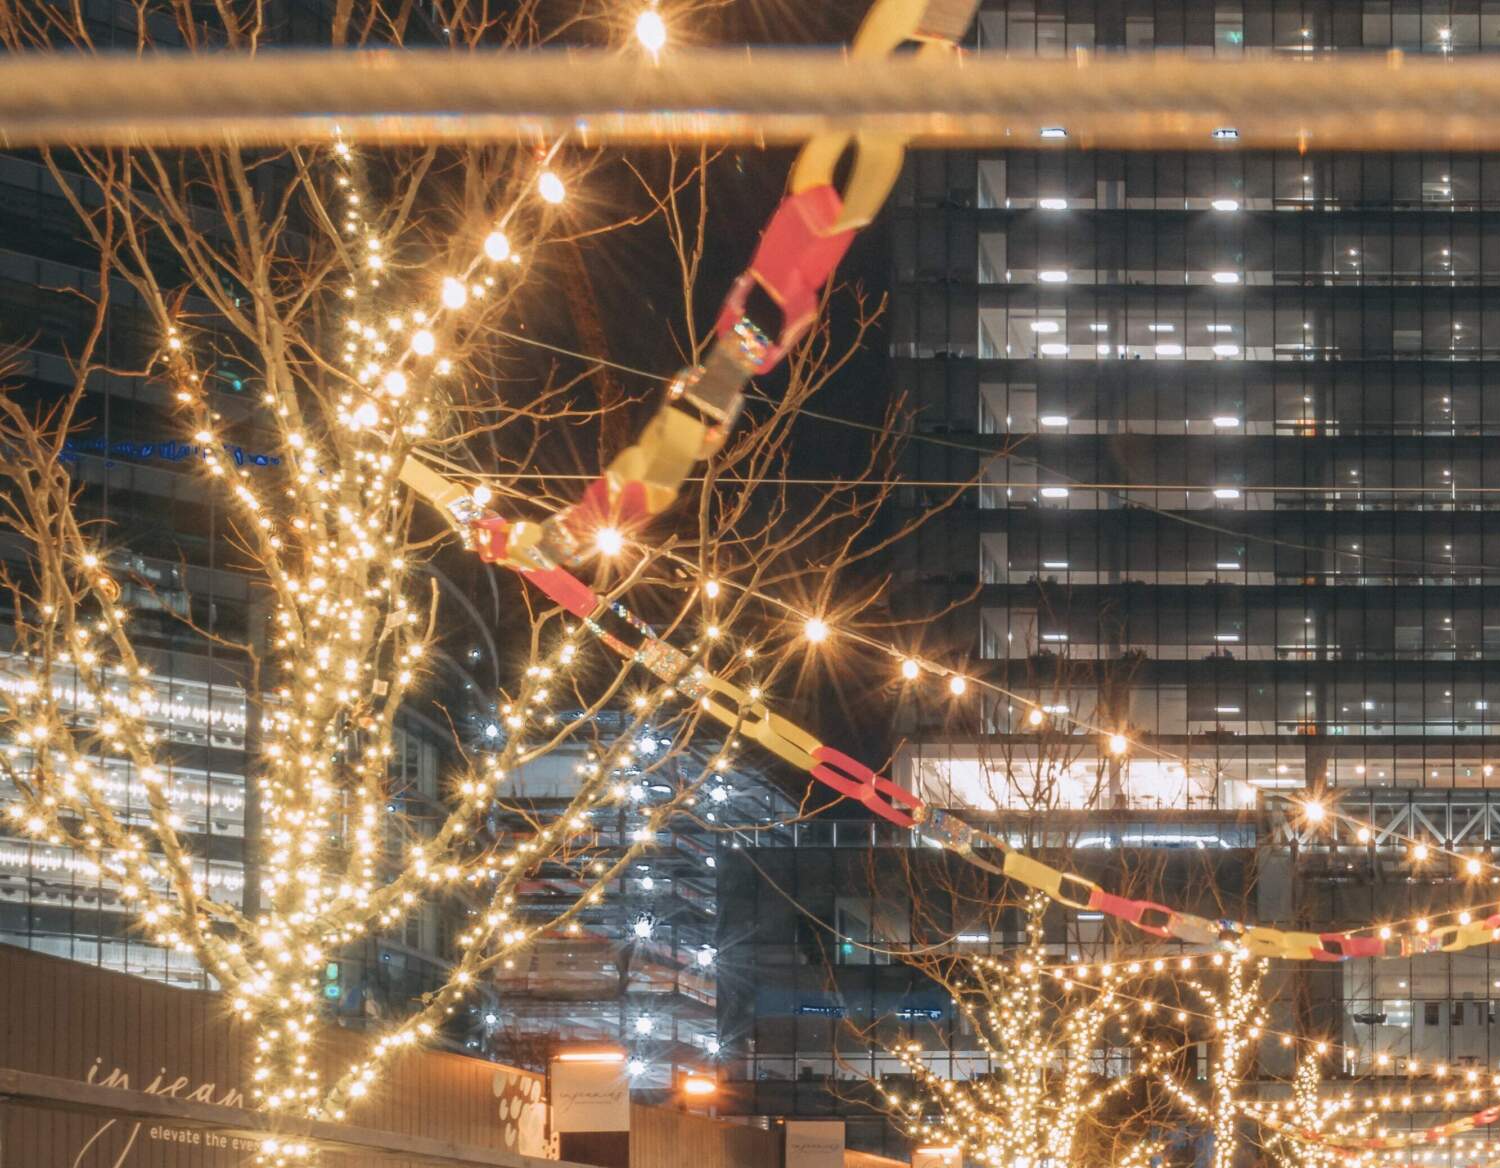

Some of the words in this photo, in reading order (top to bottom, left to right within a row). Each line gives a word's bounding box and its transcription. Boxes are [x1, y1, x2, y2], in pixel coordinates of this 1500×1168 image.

[150, 1125, 201, 1145] elevate
[205, 1132, 228, 1149] the
[231, 1138, 262, 1152] eve
